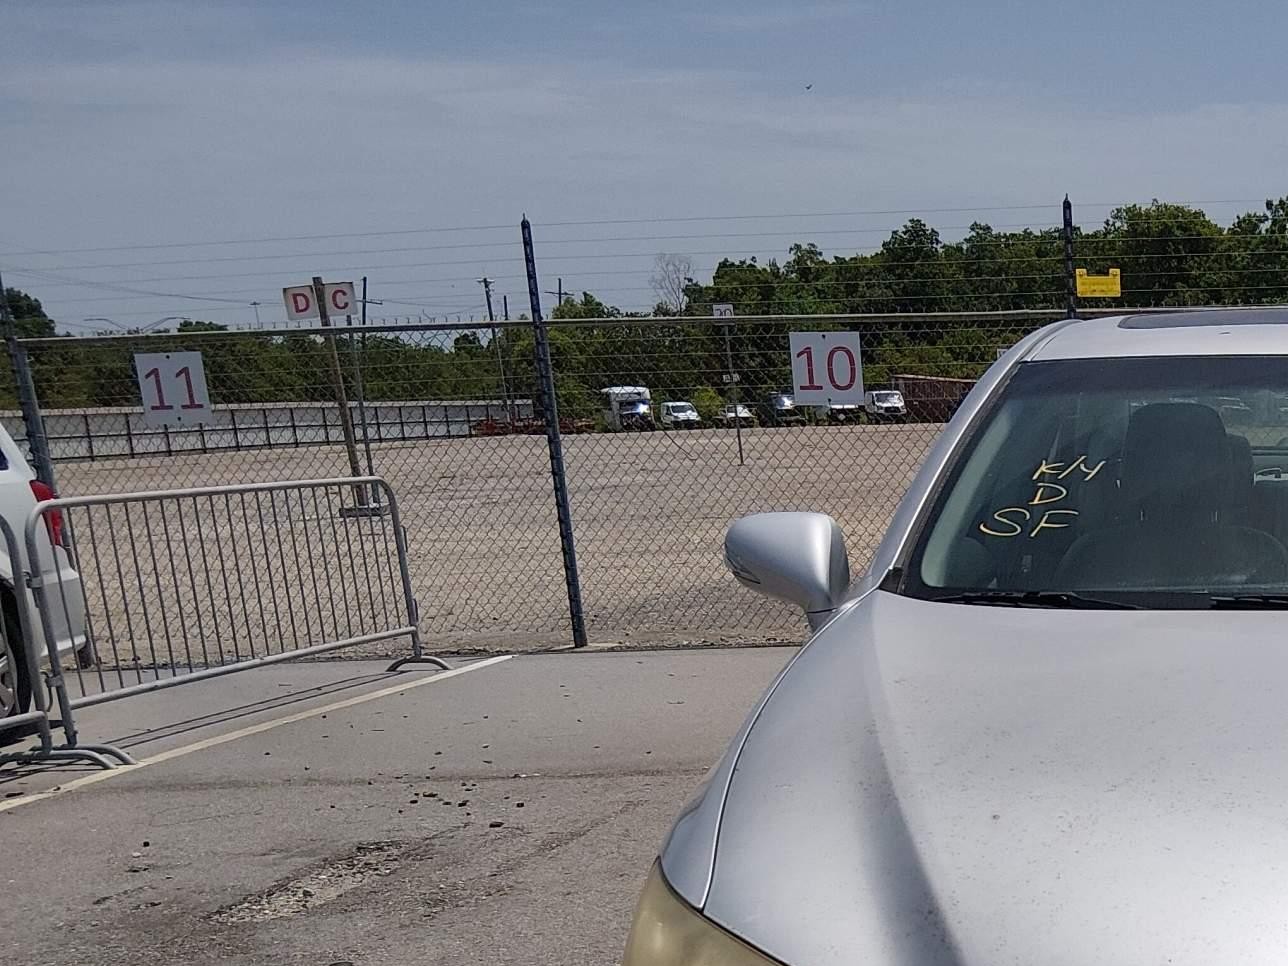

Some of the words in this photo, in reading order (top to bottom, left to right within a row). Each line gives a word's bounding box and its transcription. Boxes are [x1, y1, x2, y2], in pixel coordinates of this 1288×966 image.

[292, 292, 310, 313] D
[332, 290, 349, 310] C
[796, 346, 857, 391] 10
[144, 366, 204, 411] 11
[1028, 482, 1068, 505] D
[979, 507, 1080, 538] SF
